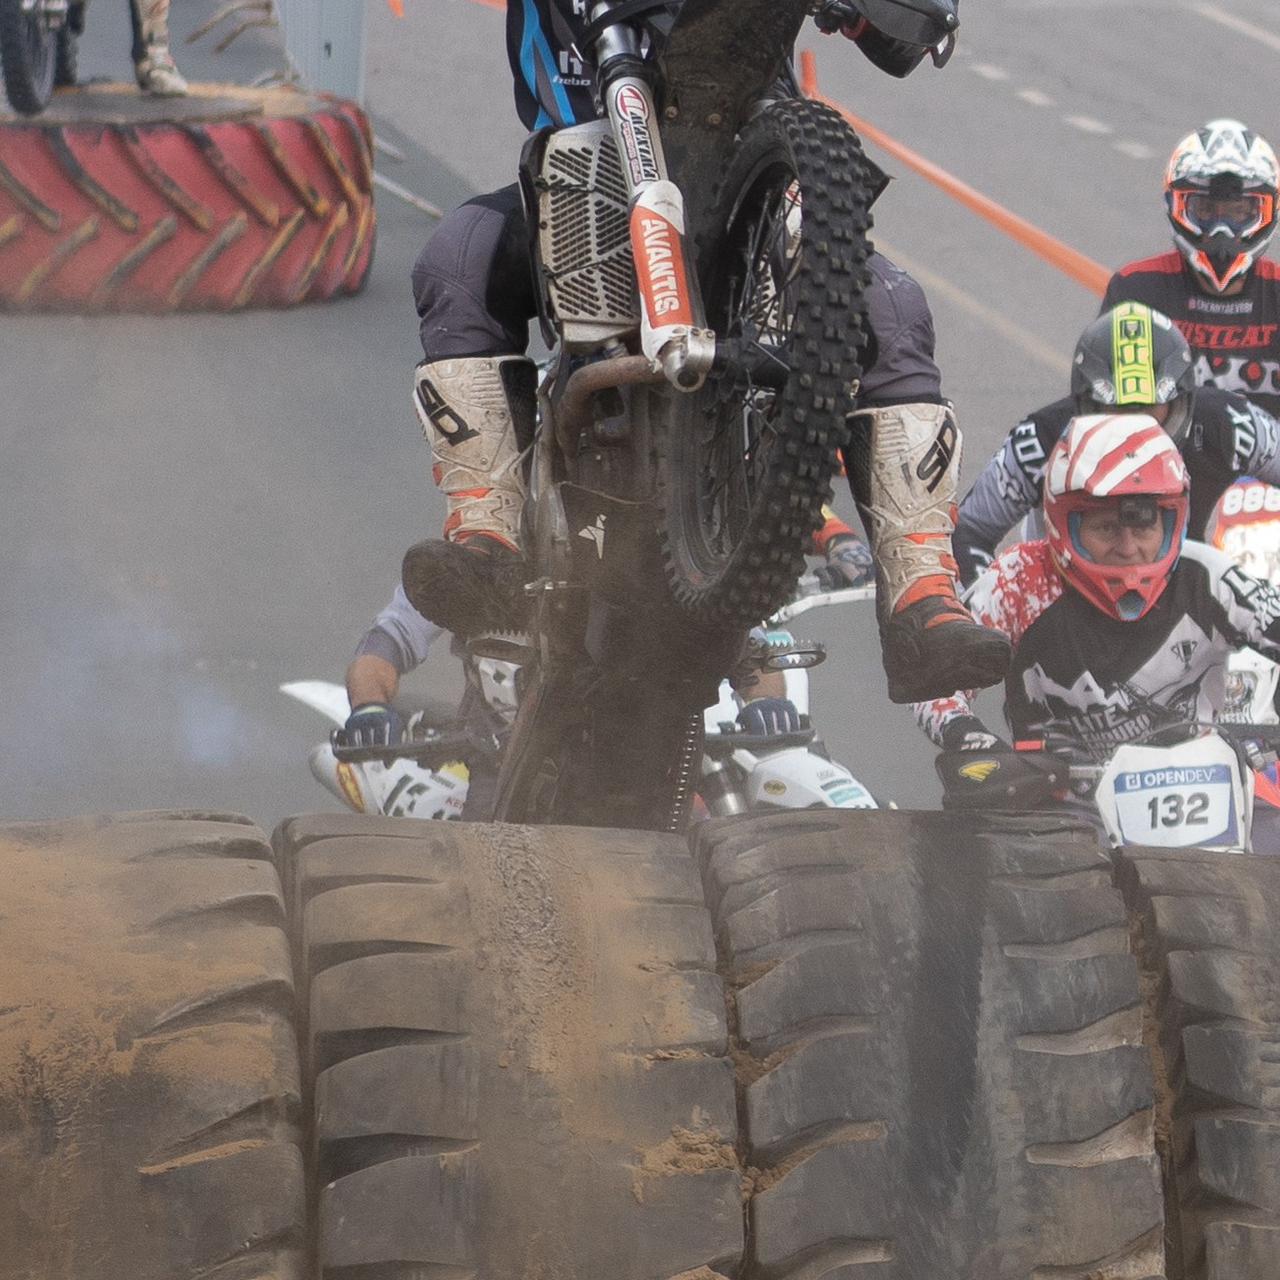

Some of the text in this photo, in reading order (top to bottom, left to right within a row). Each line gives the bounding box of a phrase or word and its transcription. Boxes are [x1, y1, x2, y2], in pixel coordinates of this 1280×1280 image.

[641, 219, 680, 316] AVANTIS
[1144, 767, 1213, 788] OPENDEV
[1147, 791, 1210, 830] 132
